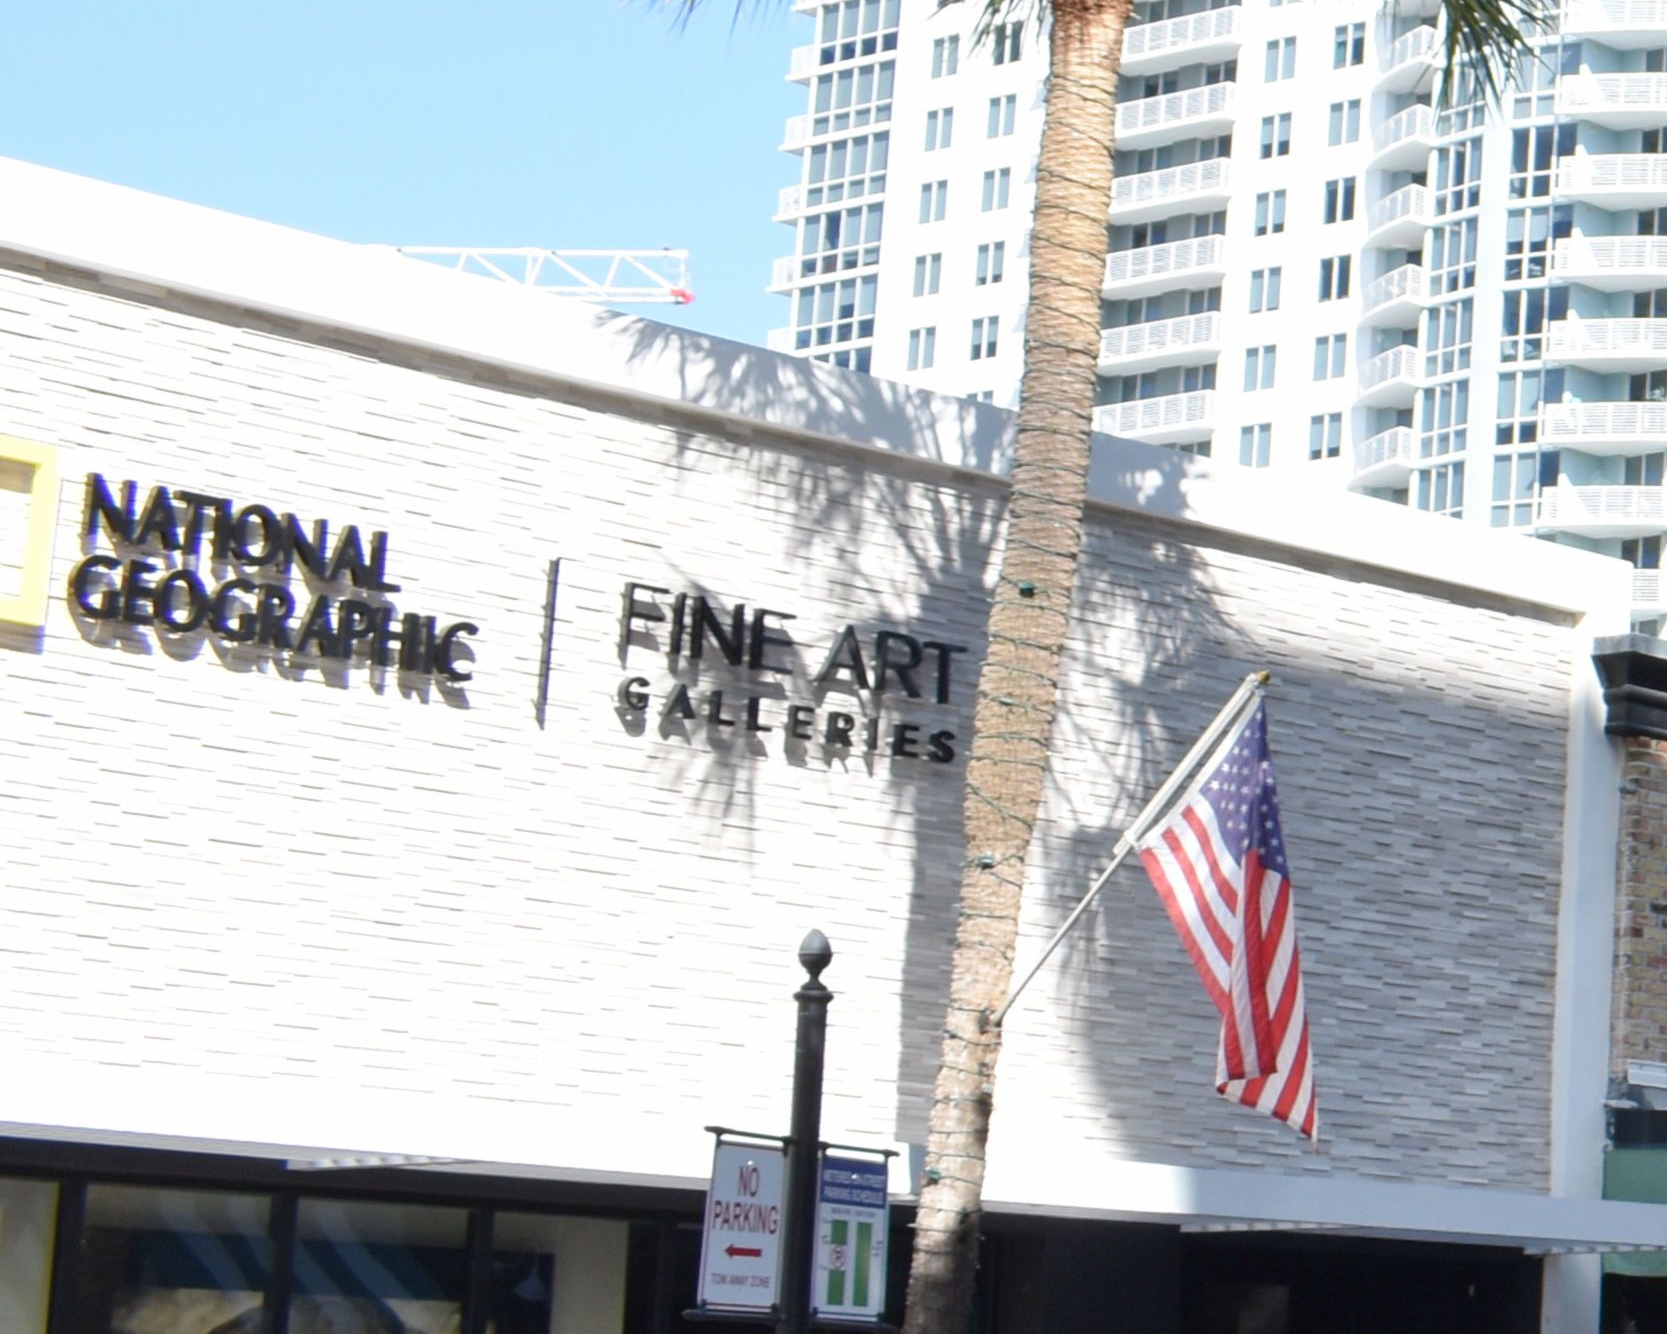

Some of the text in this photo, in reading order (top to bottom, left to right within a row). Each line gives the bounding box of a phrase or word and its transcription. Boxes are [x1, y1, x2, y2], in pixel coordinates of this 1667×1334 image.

[86, 472, 401, 593] NATIONAL
[71, 554, 480, 681] GEOGRAPHIC
[619, 582, 967, 704] FINE ART
[617, 675, 956, 763] GALLERIES
[712, 1200, 779, 1236] PARKING
[737, 1166, 761, 1197] NO
